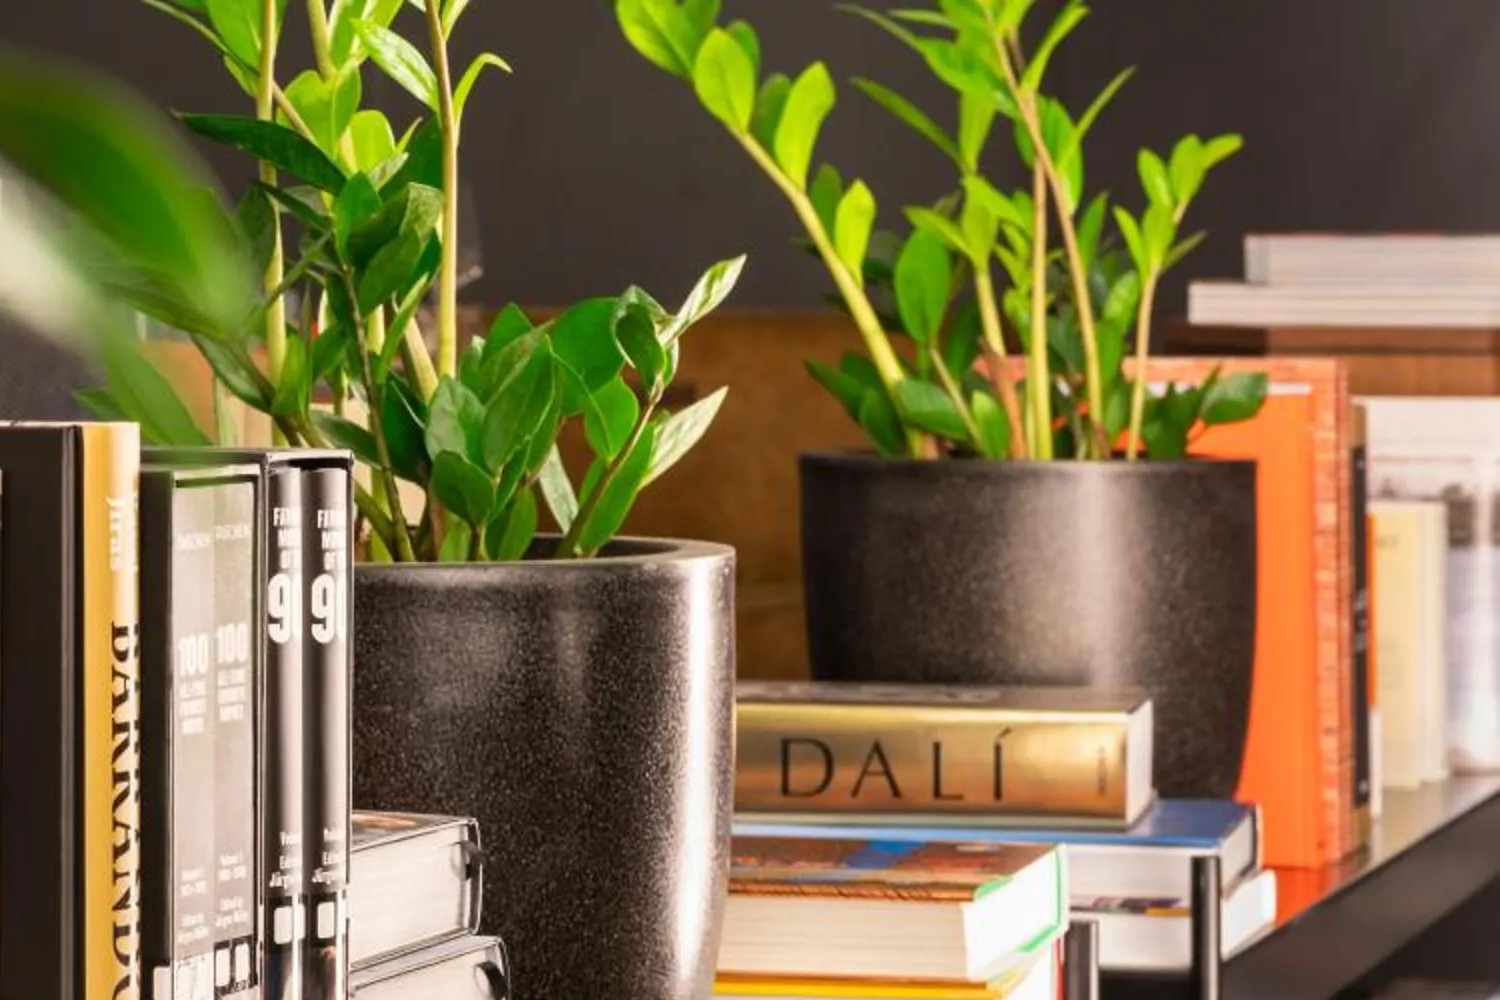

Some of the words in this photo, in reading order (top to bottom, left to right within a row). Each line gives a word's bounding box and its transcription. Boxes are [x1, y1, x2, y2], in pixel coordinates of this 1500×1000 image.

[178, 633, 209, 676] 100
[215, 623, 248, 664] 100
[780, 727, 1013, 800] DALÍ
